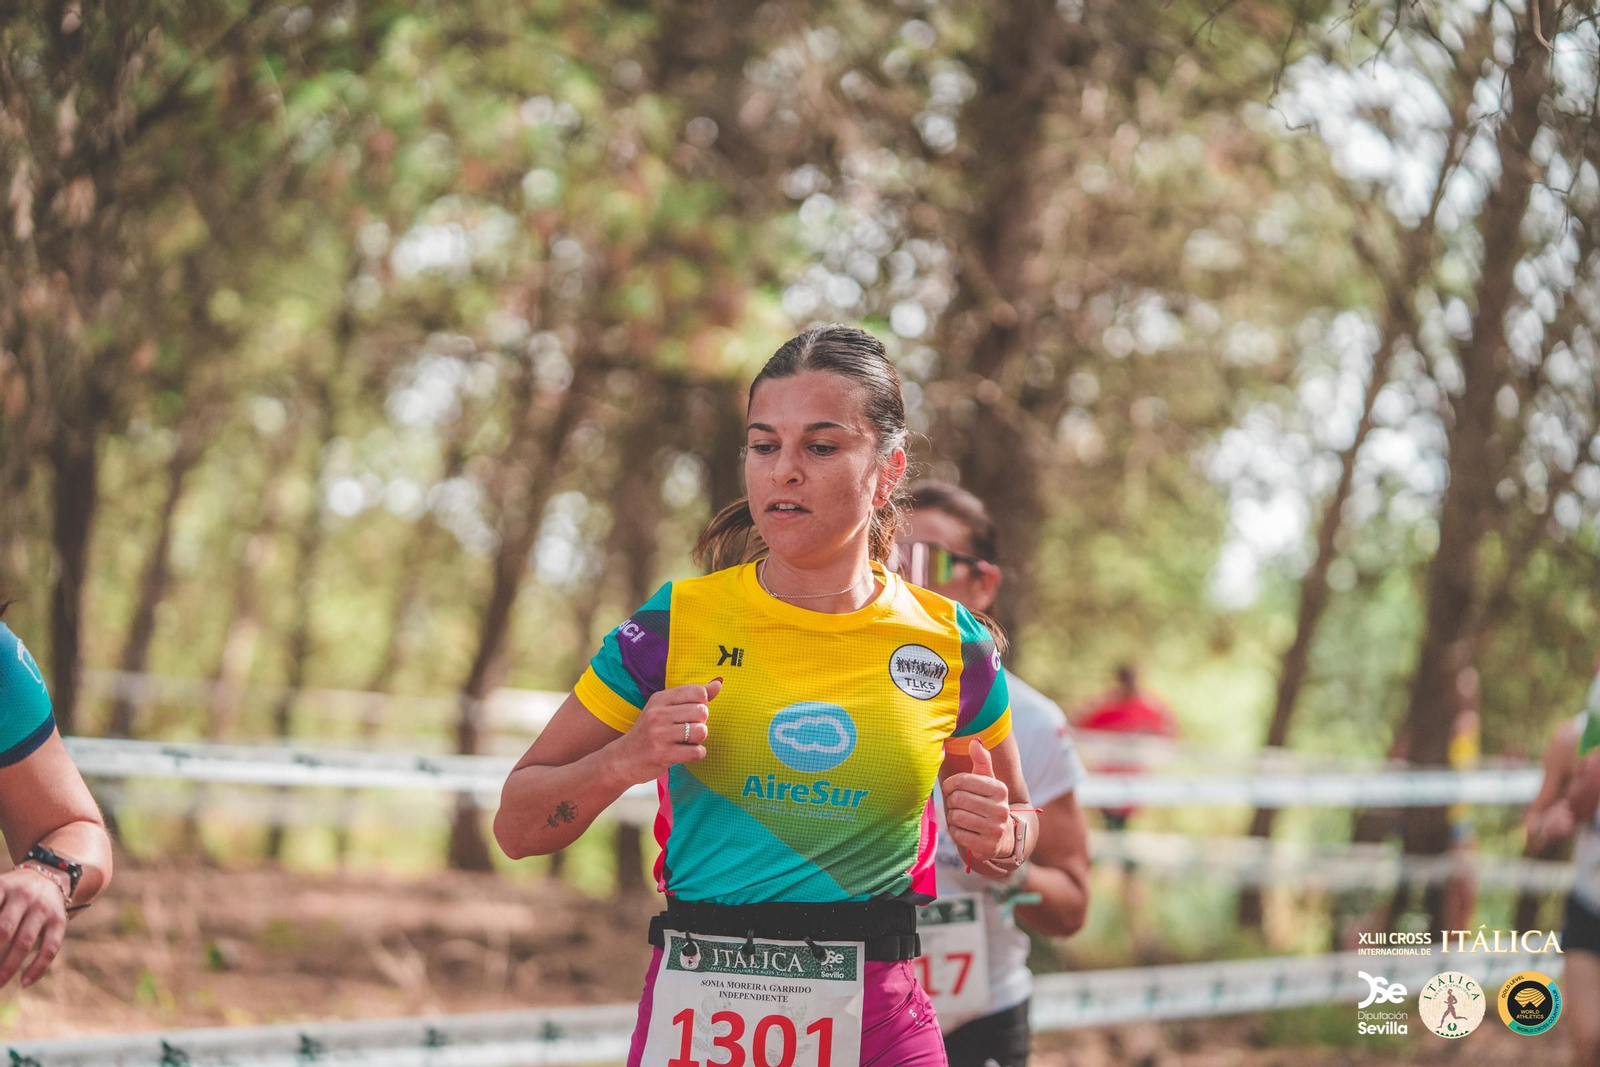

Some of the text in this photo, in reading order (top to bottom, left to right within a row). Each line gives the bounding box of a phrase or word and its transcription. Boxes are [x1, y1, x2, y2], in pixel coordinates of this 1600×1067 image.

[904, 677, 936, 690] TLKS
[741, 773, 869, 808] AireSur
[821, 971, 845, 979] Sevilla
[701, 979, 812, 994] SONIA MOREIRA GARRIDO
[719, 990, 789, 1003] INDEPENDIENTE
[667, 1007, 834, 1067] 1301
